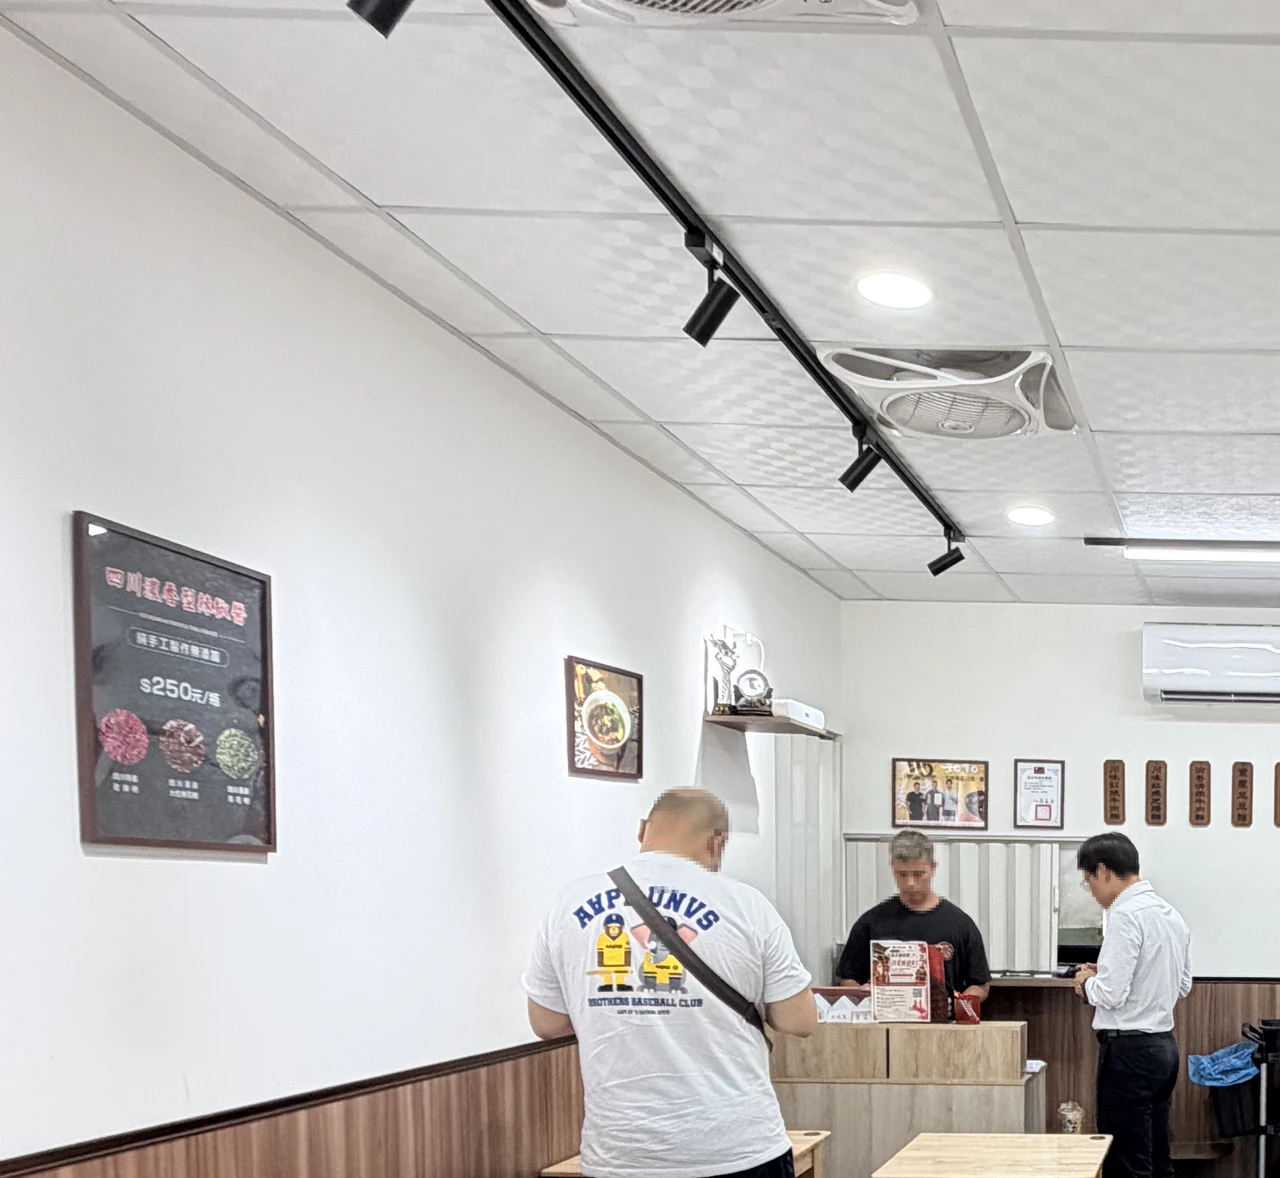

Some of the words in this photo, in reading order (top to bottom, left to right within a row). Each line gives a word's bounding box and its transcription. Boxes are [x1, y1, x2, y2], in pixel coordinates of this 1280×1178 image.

[573, 888, 633, 930] AAP
[632, 997, 677, 1007] BASEBALL
[679, 998, 703, 1008] CLUB
